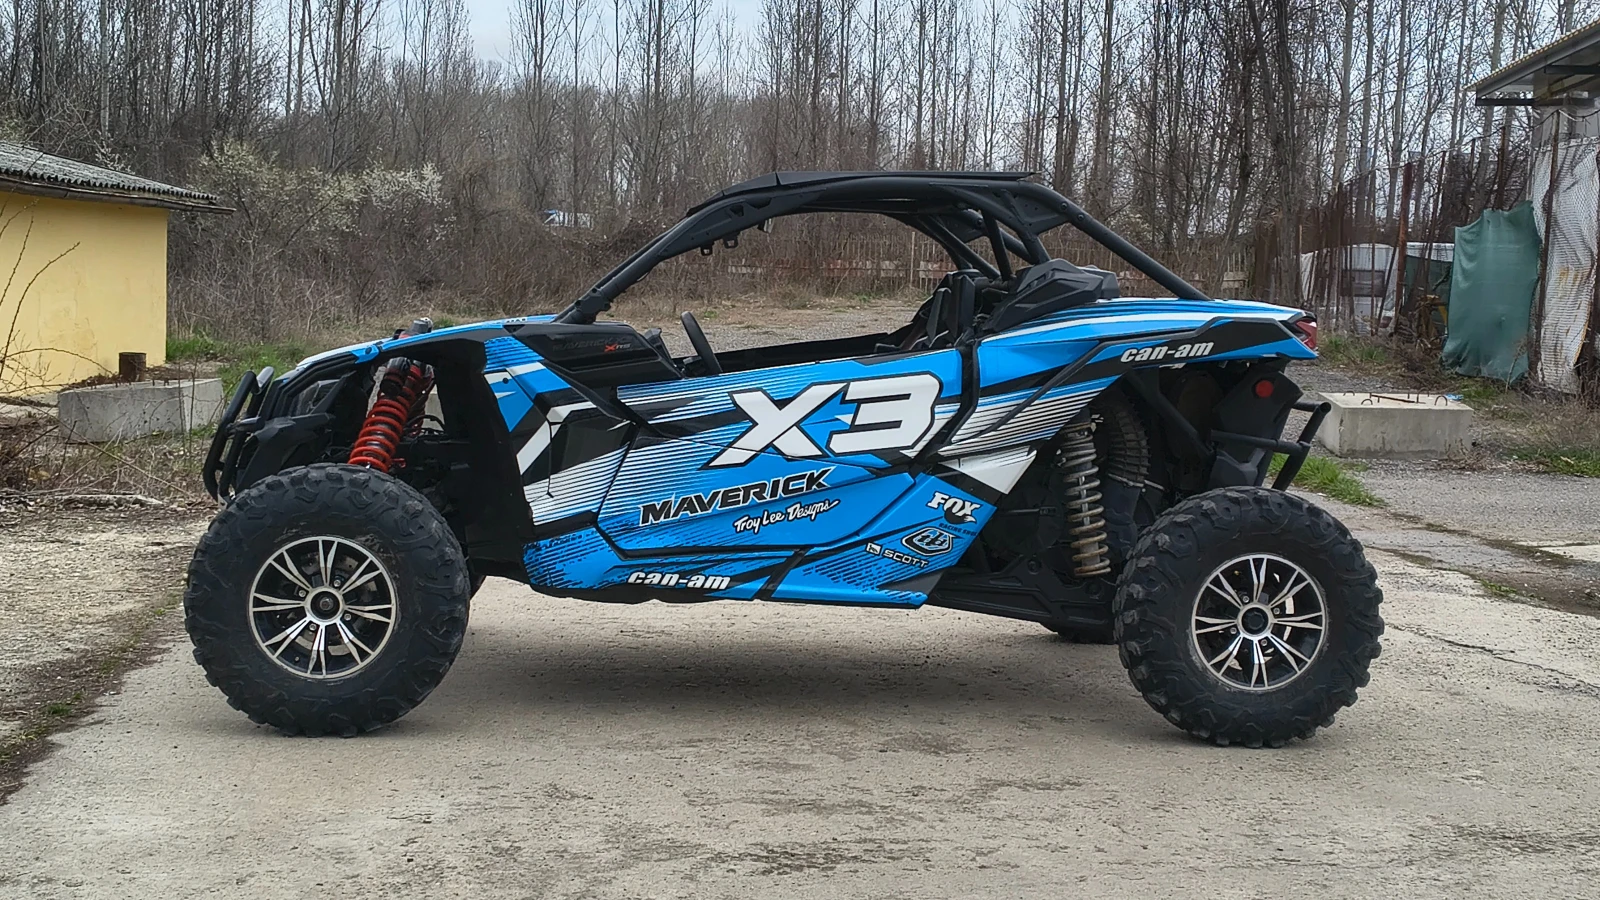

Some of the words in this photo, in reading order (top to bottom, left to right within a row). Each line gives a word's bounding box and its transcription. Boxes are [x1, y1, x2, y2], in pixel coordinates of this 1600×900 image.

[1120, 341, 1215, 363] can-am
[703, 372, 942, 468] X3
[640, 466, 836, 526] MAVERICK
[927, 491, 981, 518] FOX
[734, 515, 760, 533] Troy
[762, 510, 785, 525] Lee
[786, 500, 840, 521] Designs
[883, 549, 928, 568] SCOTT
[627, 571, 731, 590] can-am
